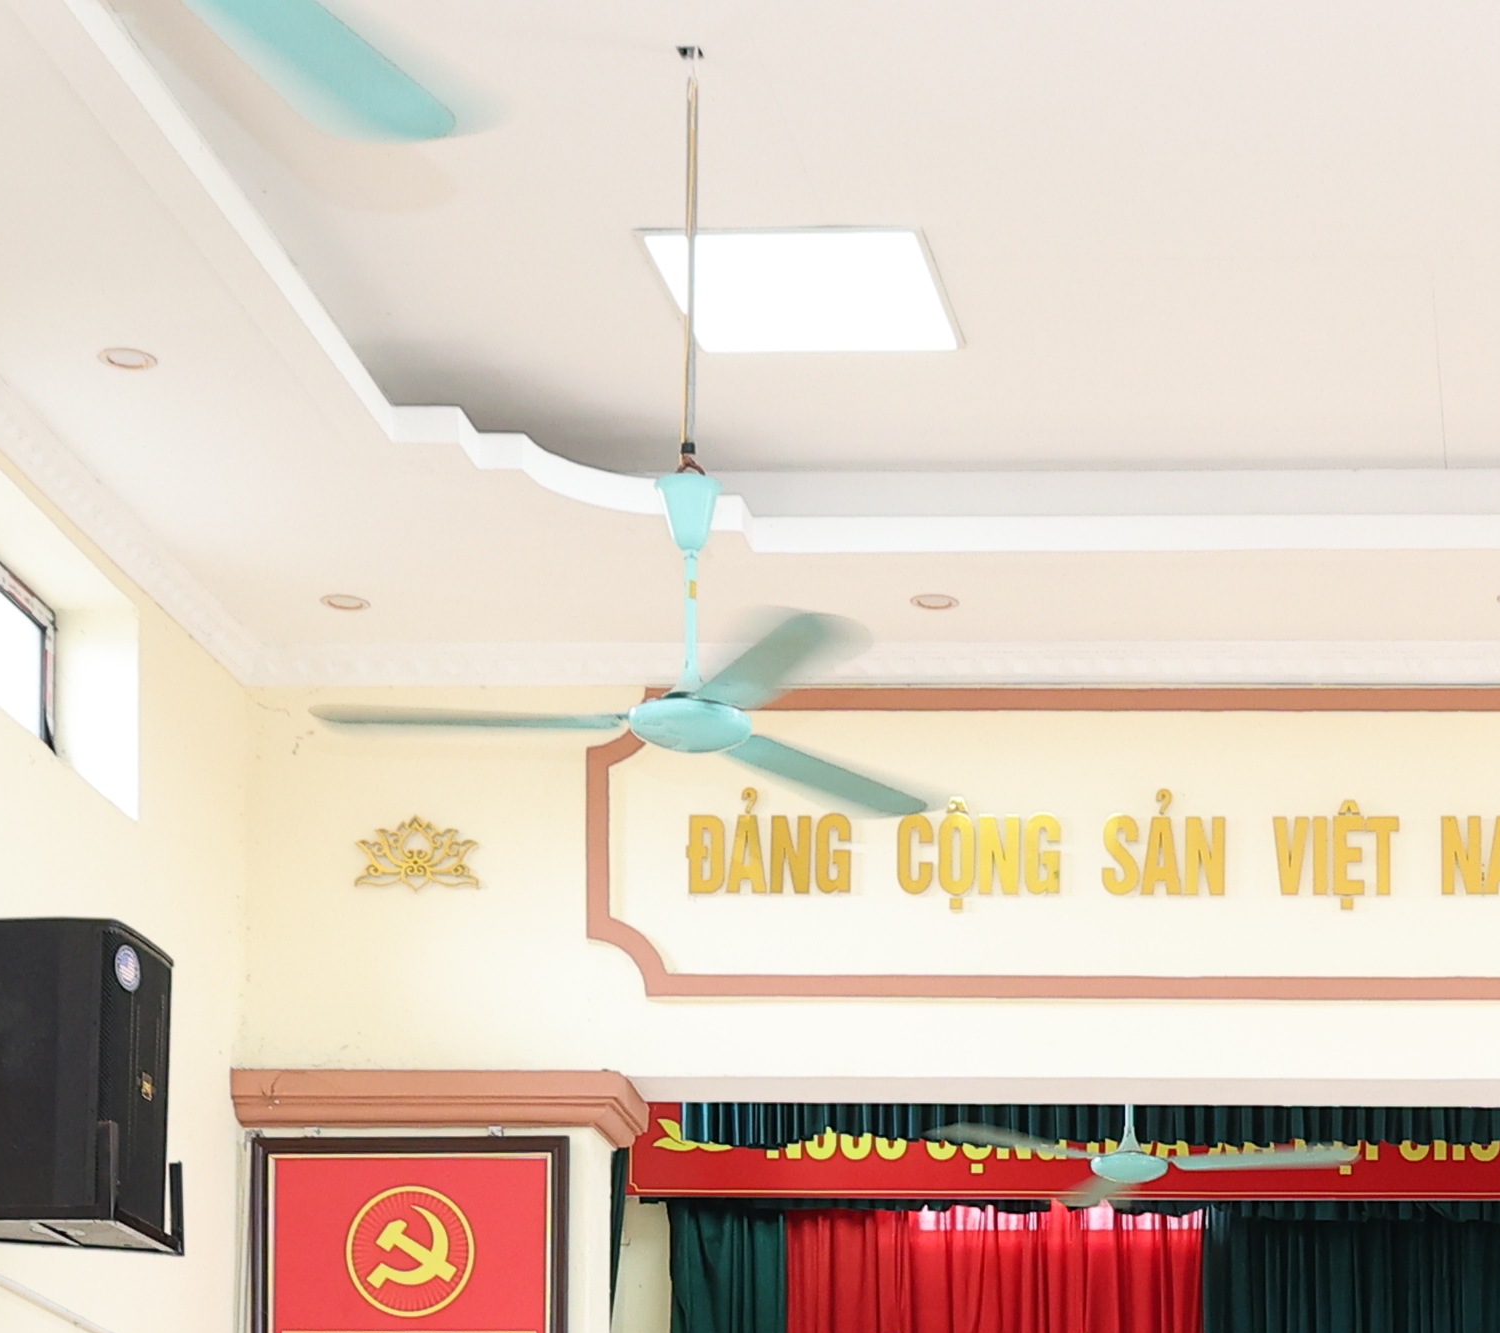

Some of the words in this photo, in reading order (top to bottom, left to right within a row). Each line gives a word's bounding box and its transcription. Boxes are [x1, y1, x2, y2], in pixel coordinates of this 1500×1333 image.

[686, 787, 852, 897] ĐẢNG
[897, 796, 1061, 911] CỘNG
[1101, 789, 1226, 897] SẢN
[1273, 799, 1400, 911] VIỆT
